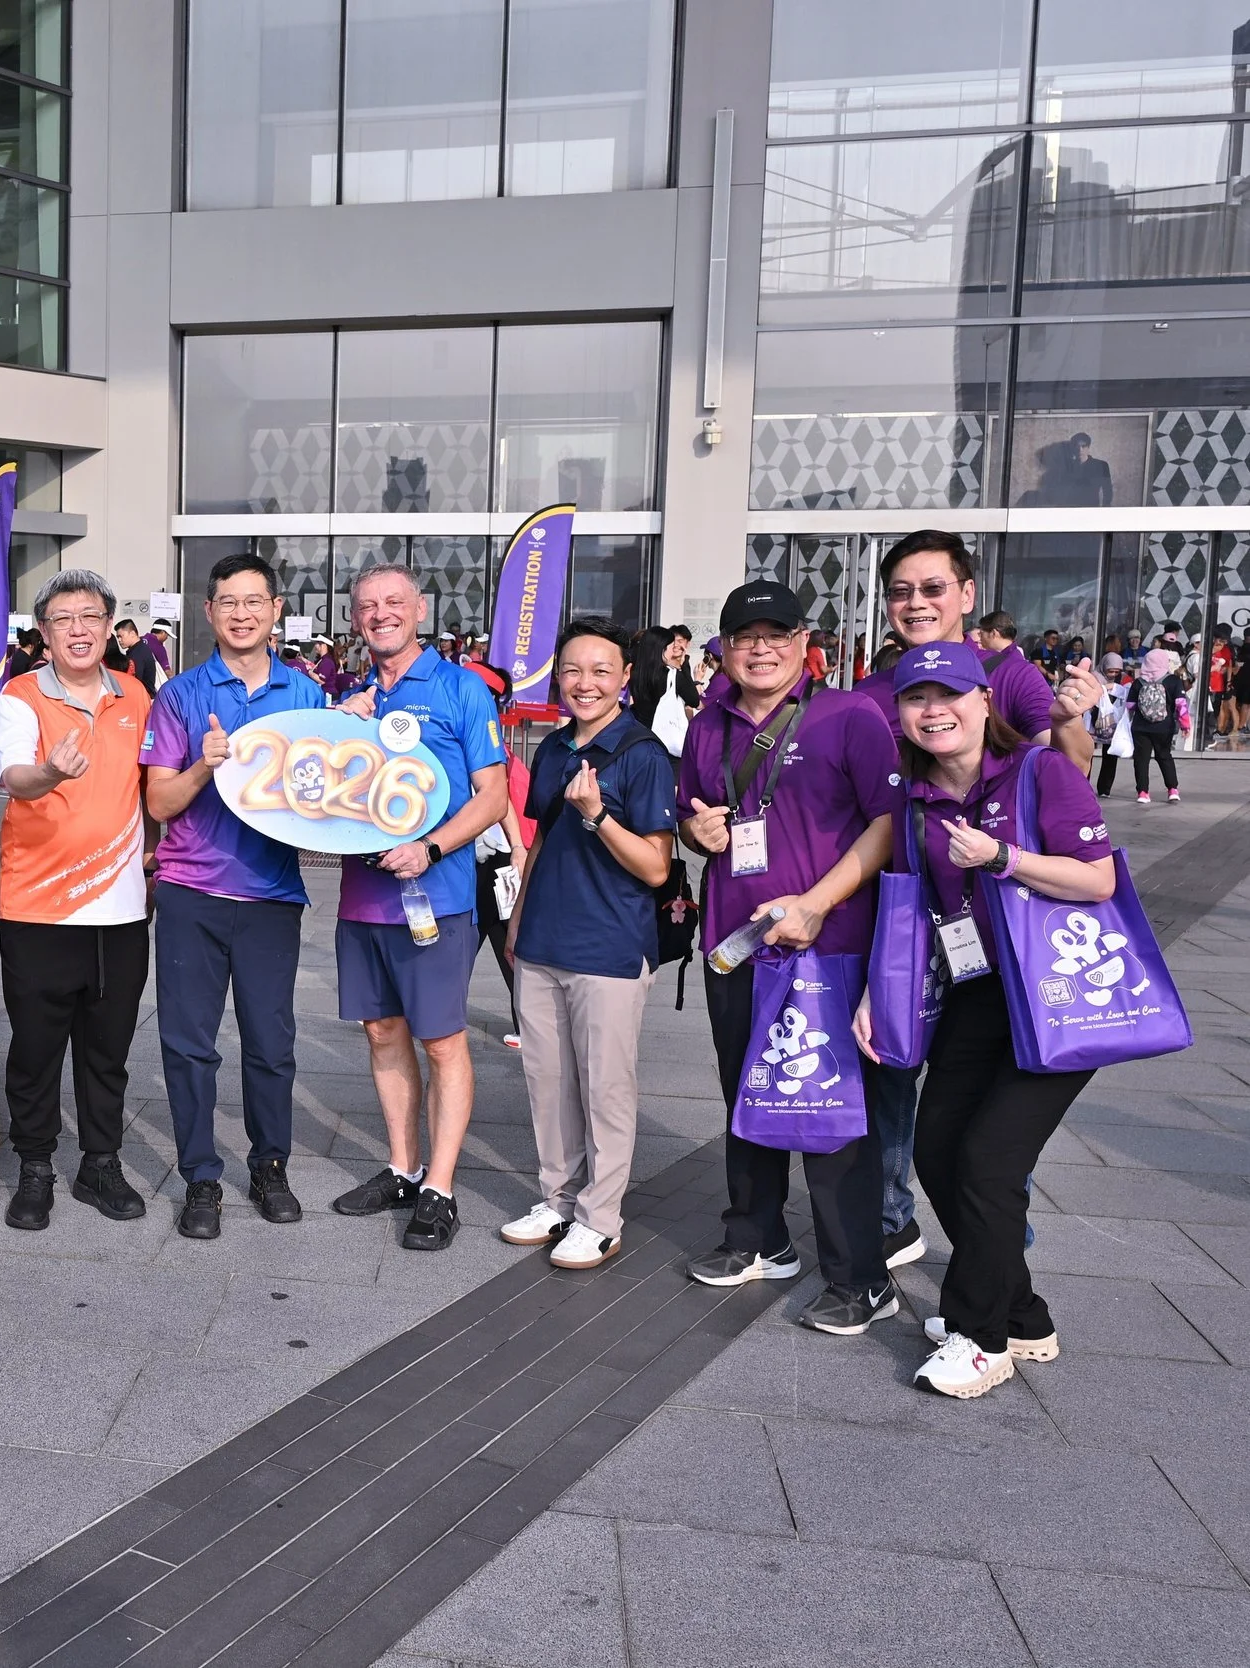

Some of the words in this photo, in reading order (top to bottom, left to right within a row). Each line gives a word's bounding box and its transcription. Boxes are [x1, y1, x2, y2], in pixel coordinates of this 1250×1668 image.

[514, 550, 543, 656] REGISTRATION
[236, 730, 436, 836] 2026
[1047, 1017, 1060, 1027] To
[1062, 1015, 1084, 1025] Serve
[1087, 1012, 1103, 1021] with
[1106, 1010, 1125, 1020] Love
[1127, 1007, 1140, 1016] and
[1142, 1005, 1161, 1016] Care
[744, 1097, 753, 1106] To
[754, 1098, 772, 1107] Serve
[774, 1099, 789, 1107] with
[791, 1099, 808, 1107] Love
[810, 1099, 823, 1107] and
[825, 1098, 844, 1108] Care
